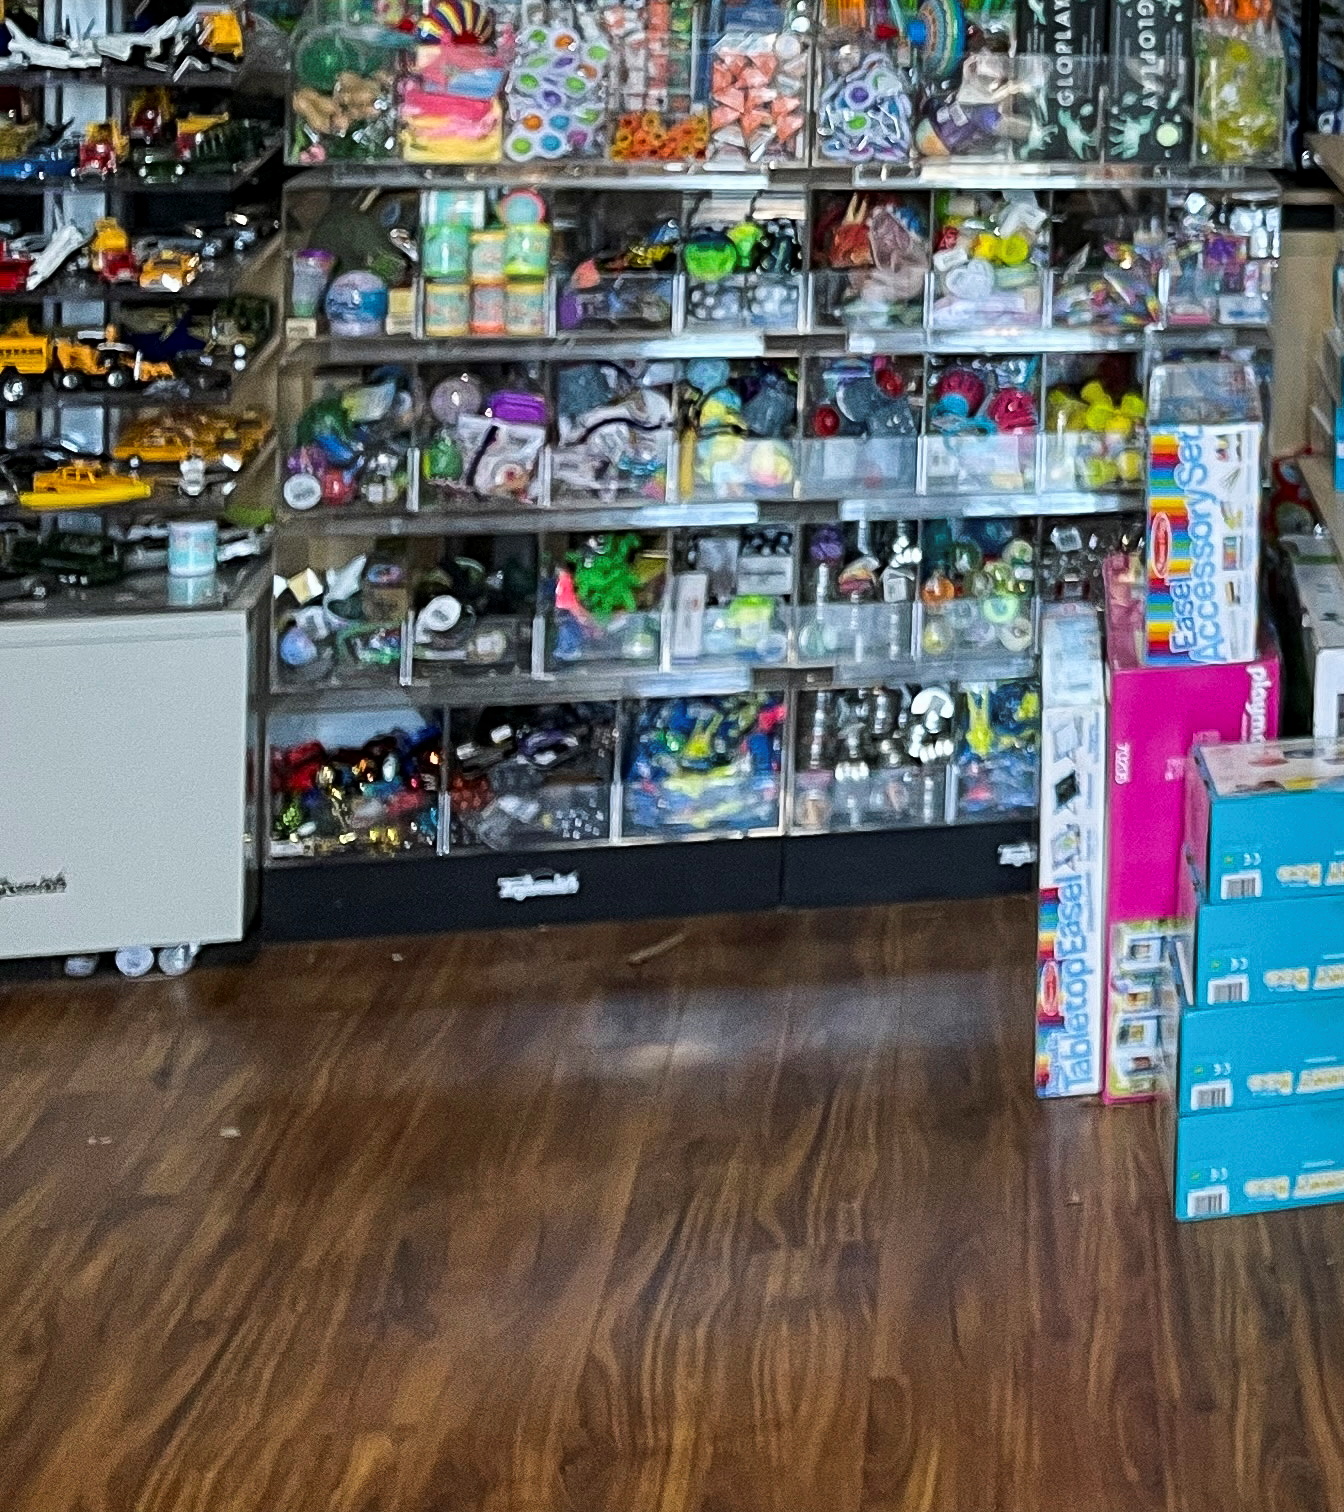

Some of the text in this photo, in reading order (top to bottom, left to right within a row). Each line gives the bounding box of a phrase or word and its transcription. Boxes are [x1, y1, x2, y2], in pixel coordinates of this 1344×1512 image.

[1174, 424, 1209, 487] Set
[1171, 577, 1199, 652] Easel
[1191, 490, 1227, 661] Accessory
[1055, 873, 1083, 959] Easel
[1063, 958, 1093, 1094] Tabletop
